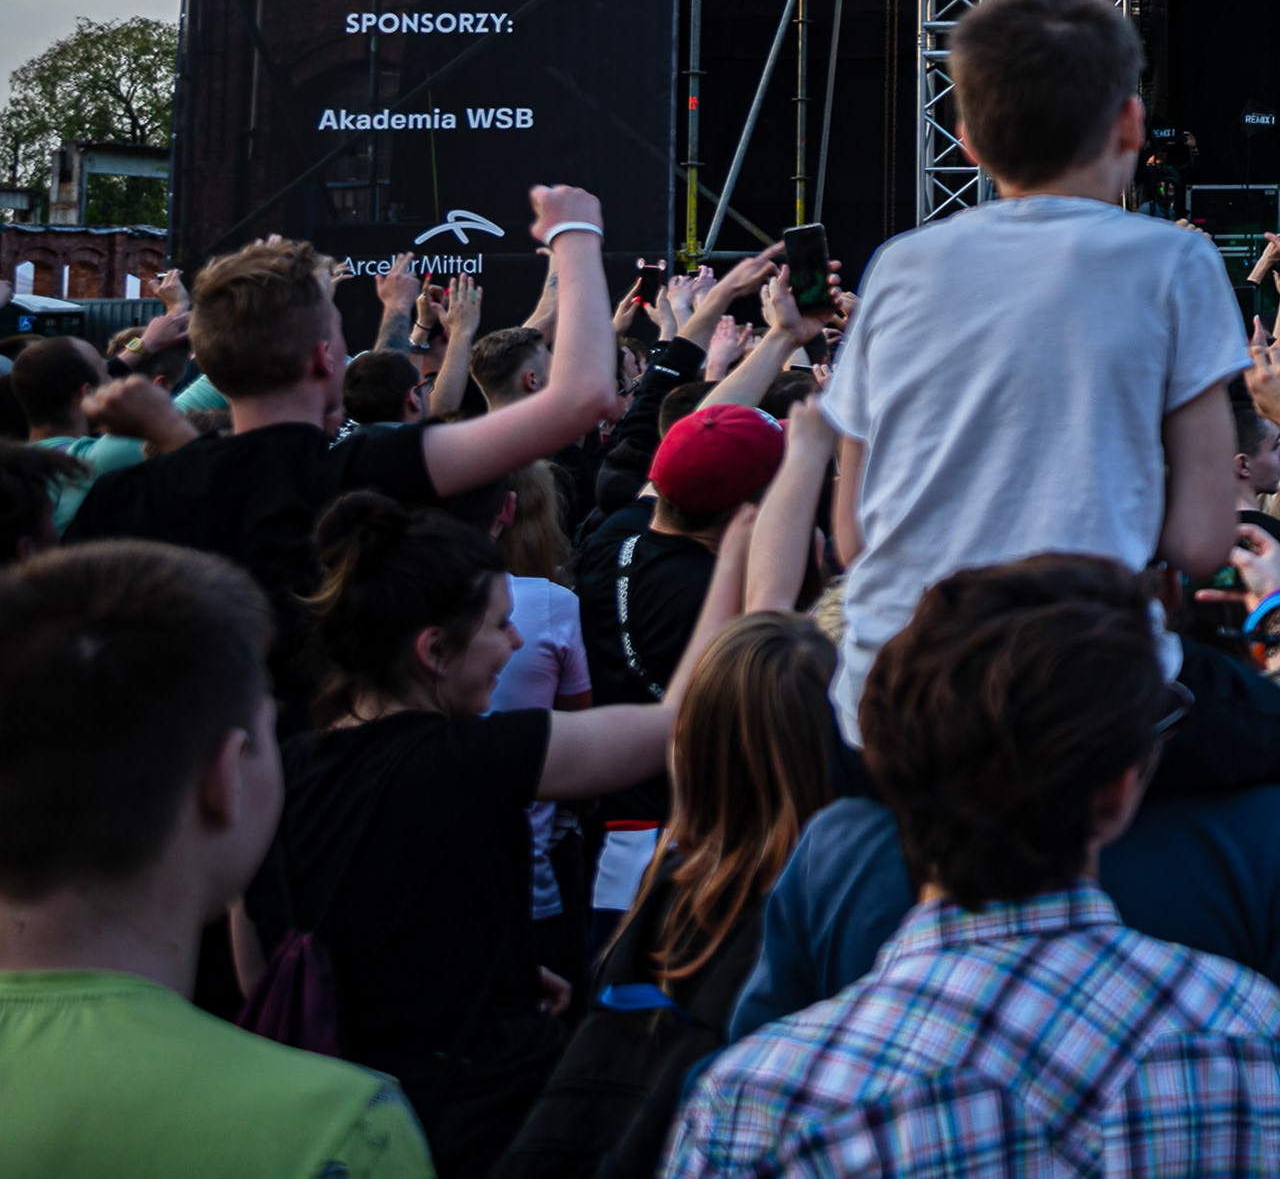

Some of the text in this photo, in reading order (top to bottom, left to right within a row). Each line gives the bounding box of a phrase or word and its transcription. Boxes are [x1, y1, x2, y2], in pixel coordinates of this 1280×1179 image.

[345, 11, 514, 35] SPONSORZY:
[317, 106, 535, 132] Akademia WSB
[344, 253, 484, 276] ArcelrMittal
